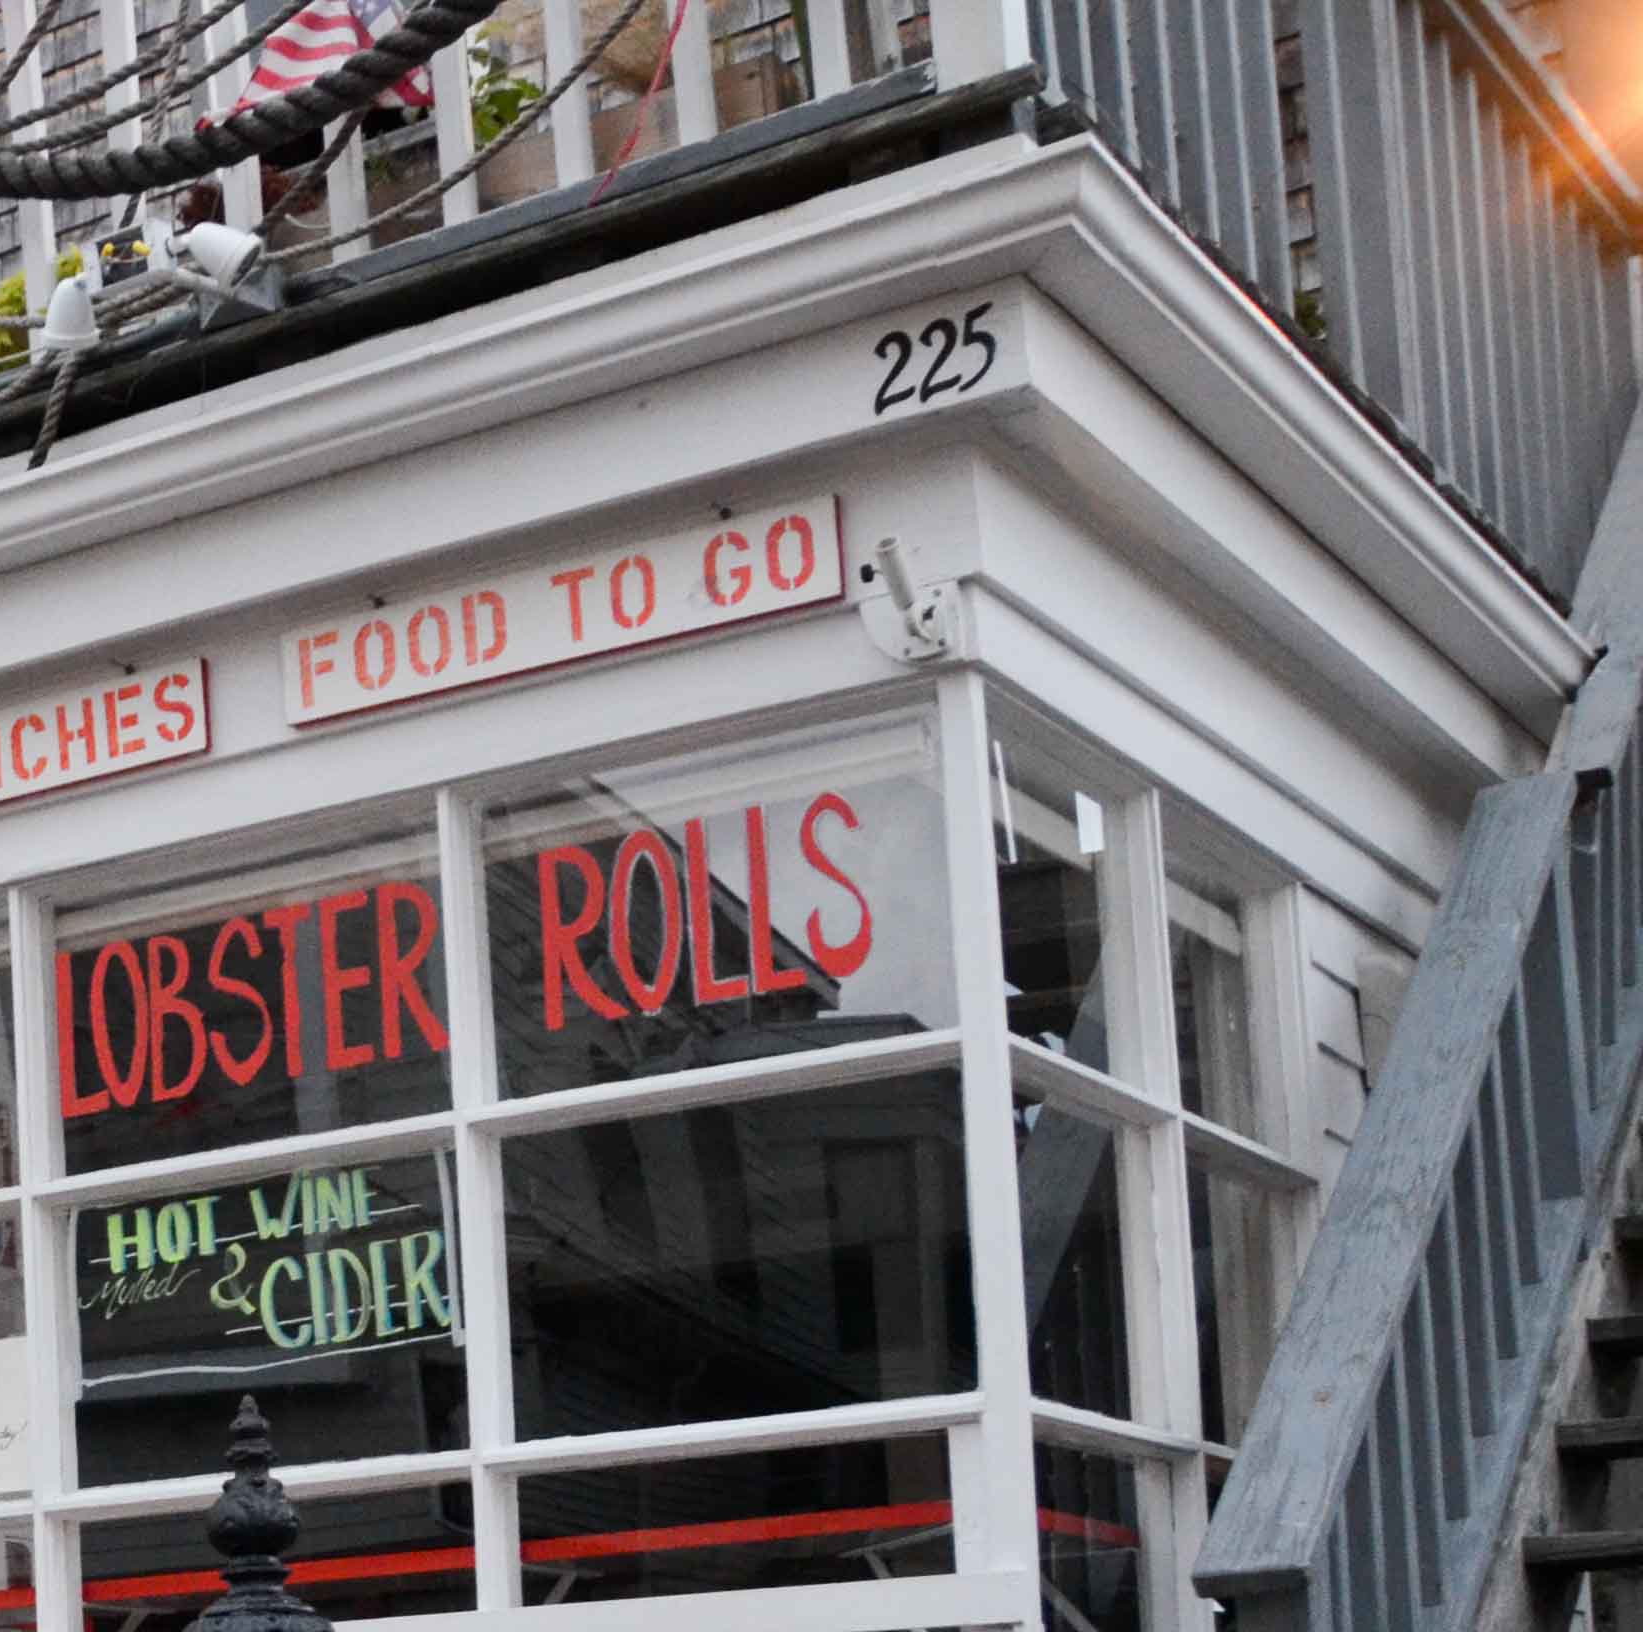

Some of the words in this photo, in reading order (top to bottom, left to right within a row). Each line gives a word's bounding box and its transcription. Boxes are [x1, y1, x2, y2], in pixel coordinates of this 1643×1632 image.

[875, 301, 997, 415] 225
[297, 590, 508, 709] FOOD
[551, 553, 656, 642] TO
[702, 513, 816, 608] GO
[54, 881, 450, 1119] LOBSTER
[537, 791, 873, 1031] ROLLS
[107, 1196, 220, 1274] HOT
[249, 1167, 379, 1240] WINE
[210, 1242, 256, 1315] &
[260, 1230, 454, 1350] CIDER
